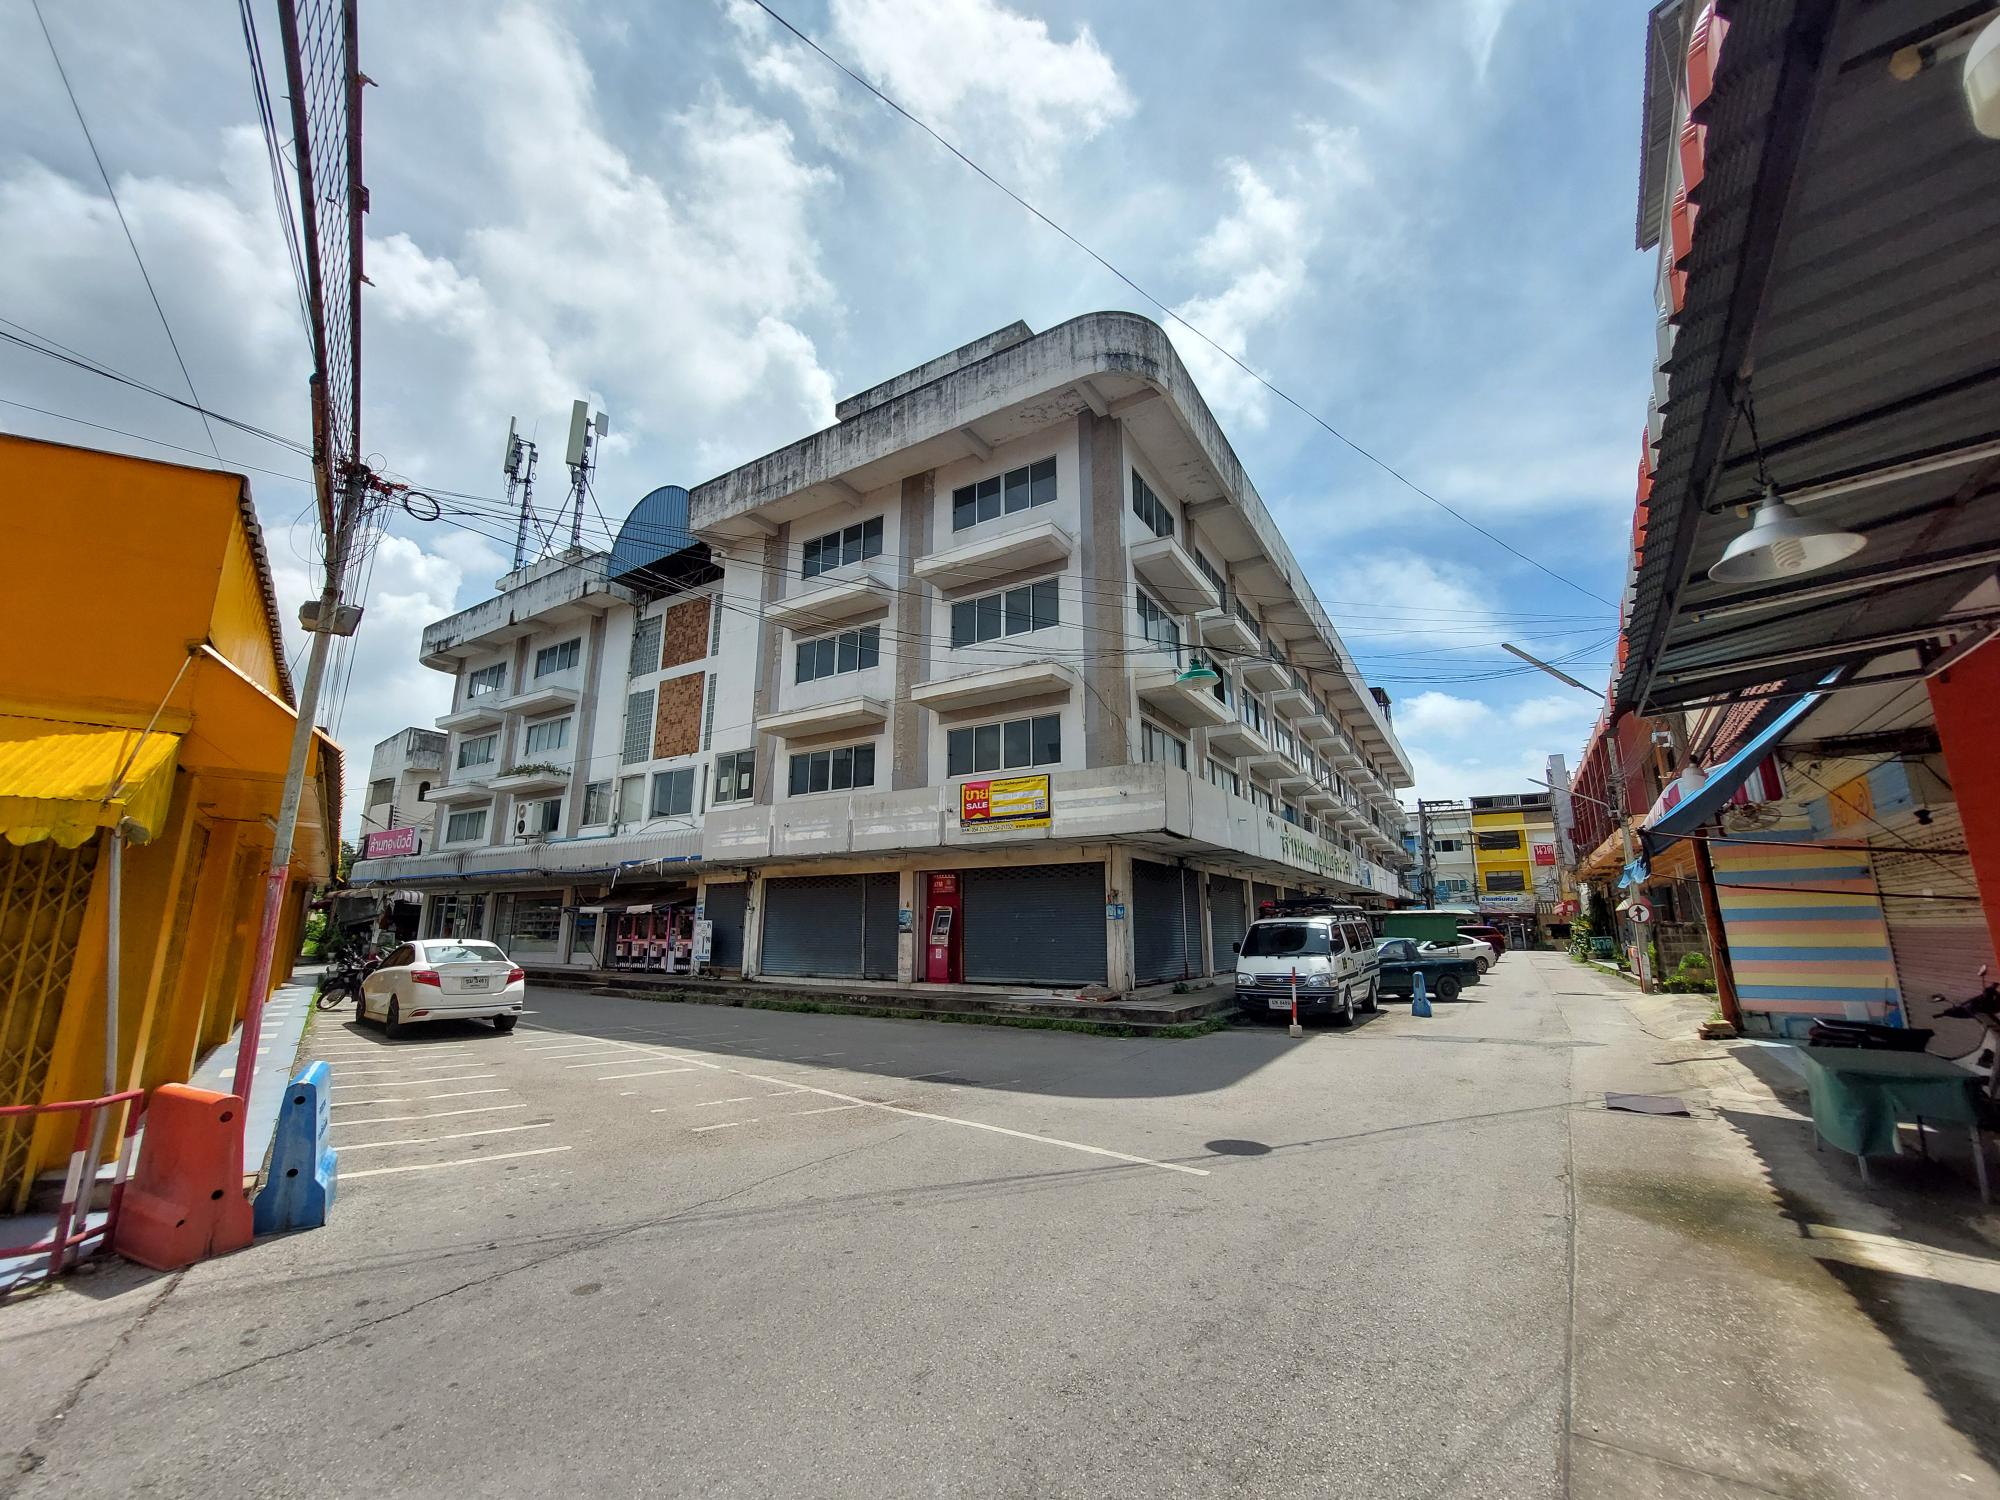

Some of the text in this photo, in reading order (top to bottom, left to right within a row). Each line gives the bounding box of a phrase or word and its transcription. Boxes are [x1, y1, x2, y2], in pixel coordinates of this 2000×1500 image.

[965, 789, 989, 801] ขาย
[966, 801, 988, 810] SALE
[1535, 845, 1553, 855] นวด
